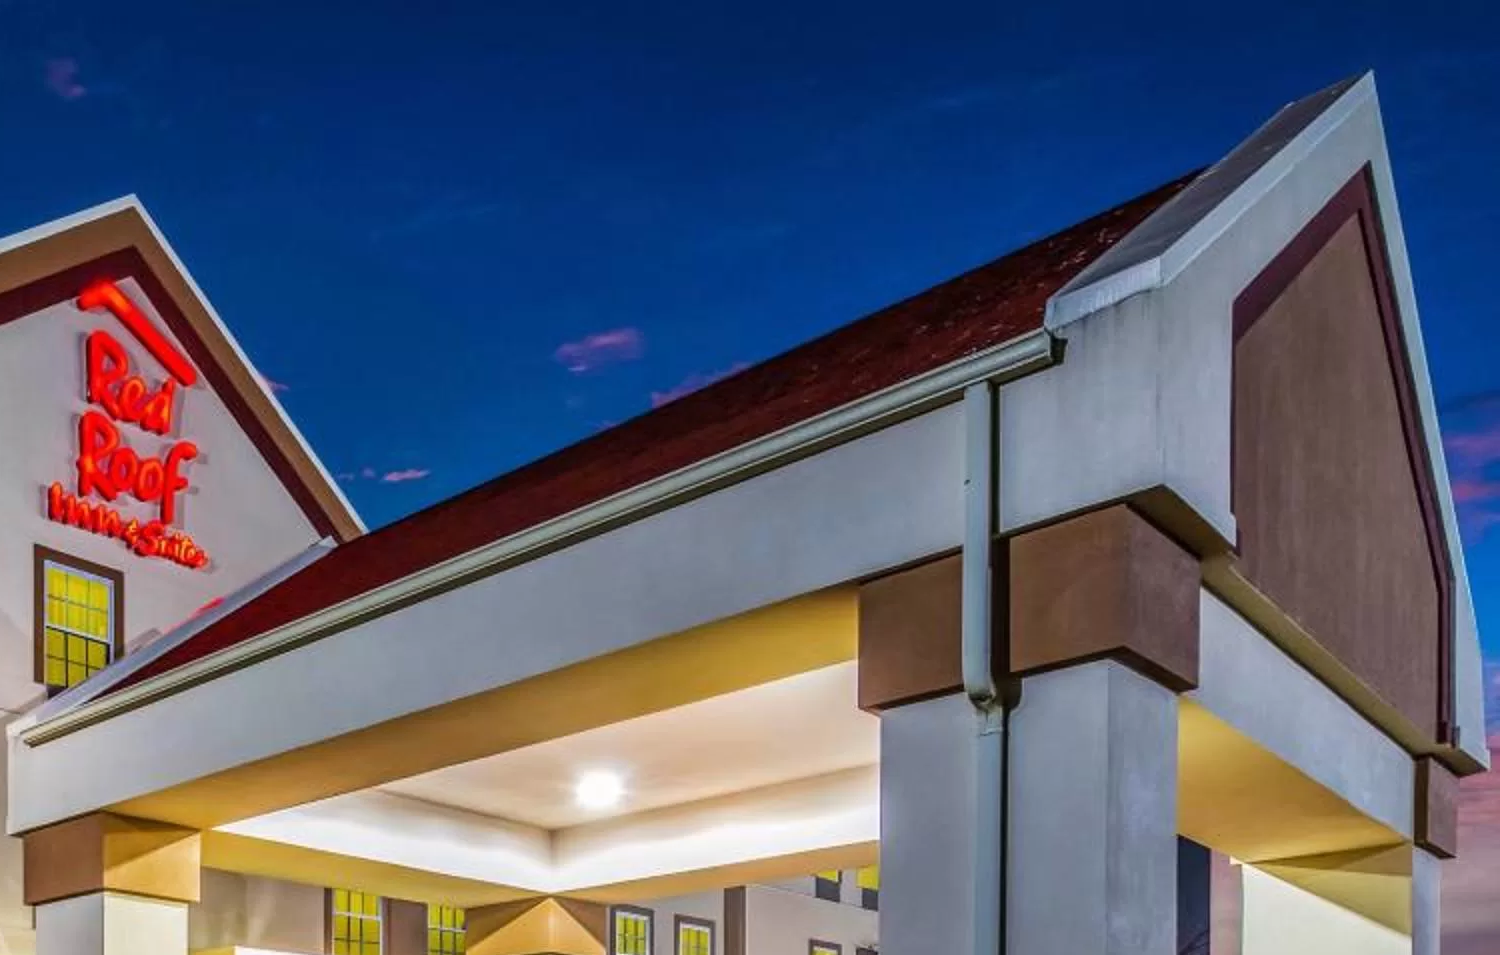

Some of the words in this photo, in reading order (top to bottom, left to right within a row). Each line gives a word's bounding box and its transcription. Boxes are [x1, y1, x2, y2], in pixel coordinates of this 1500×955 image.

[86, 330, 176, 436] Red
[77, 410, 198, 525] Roof
[47, 481, 124, 538] Inn
[133, 519, 210, 569] Suites
